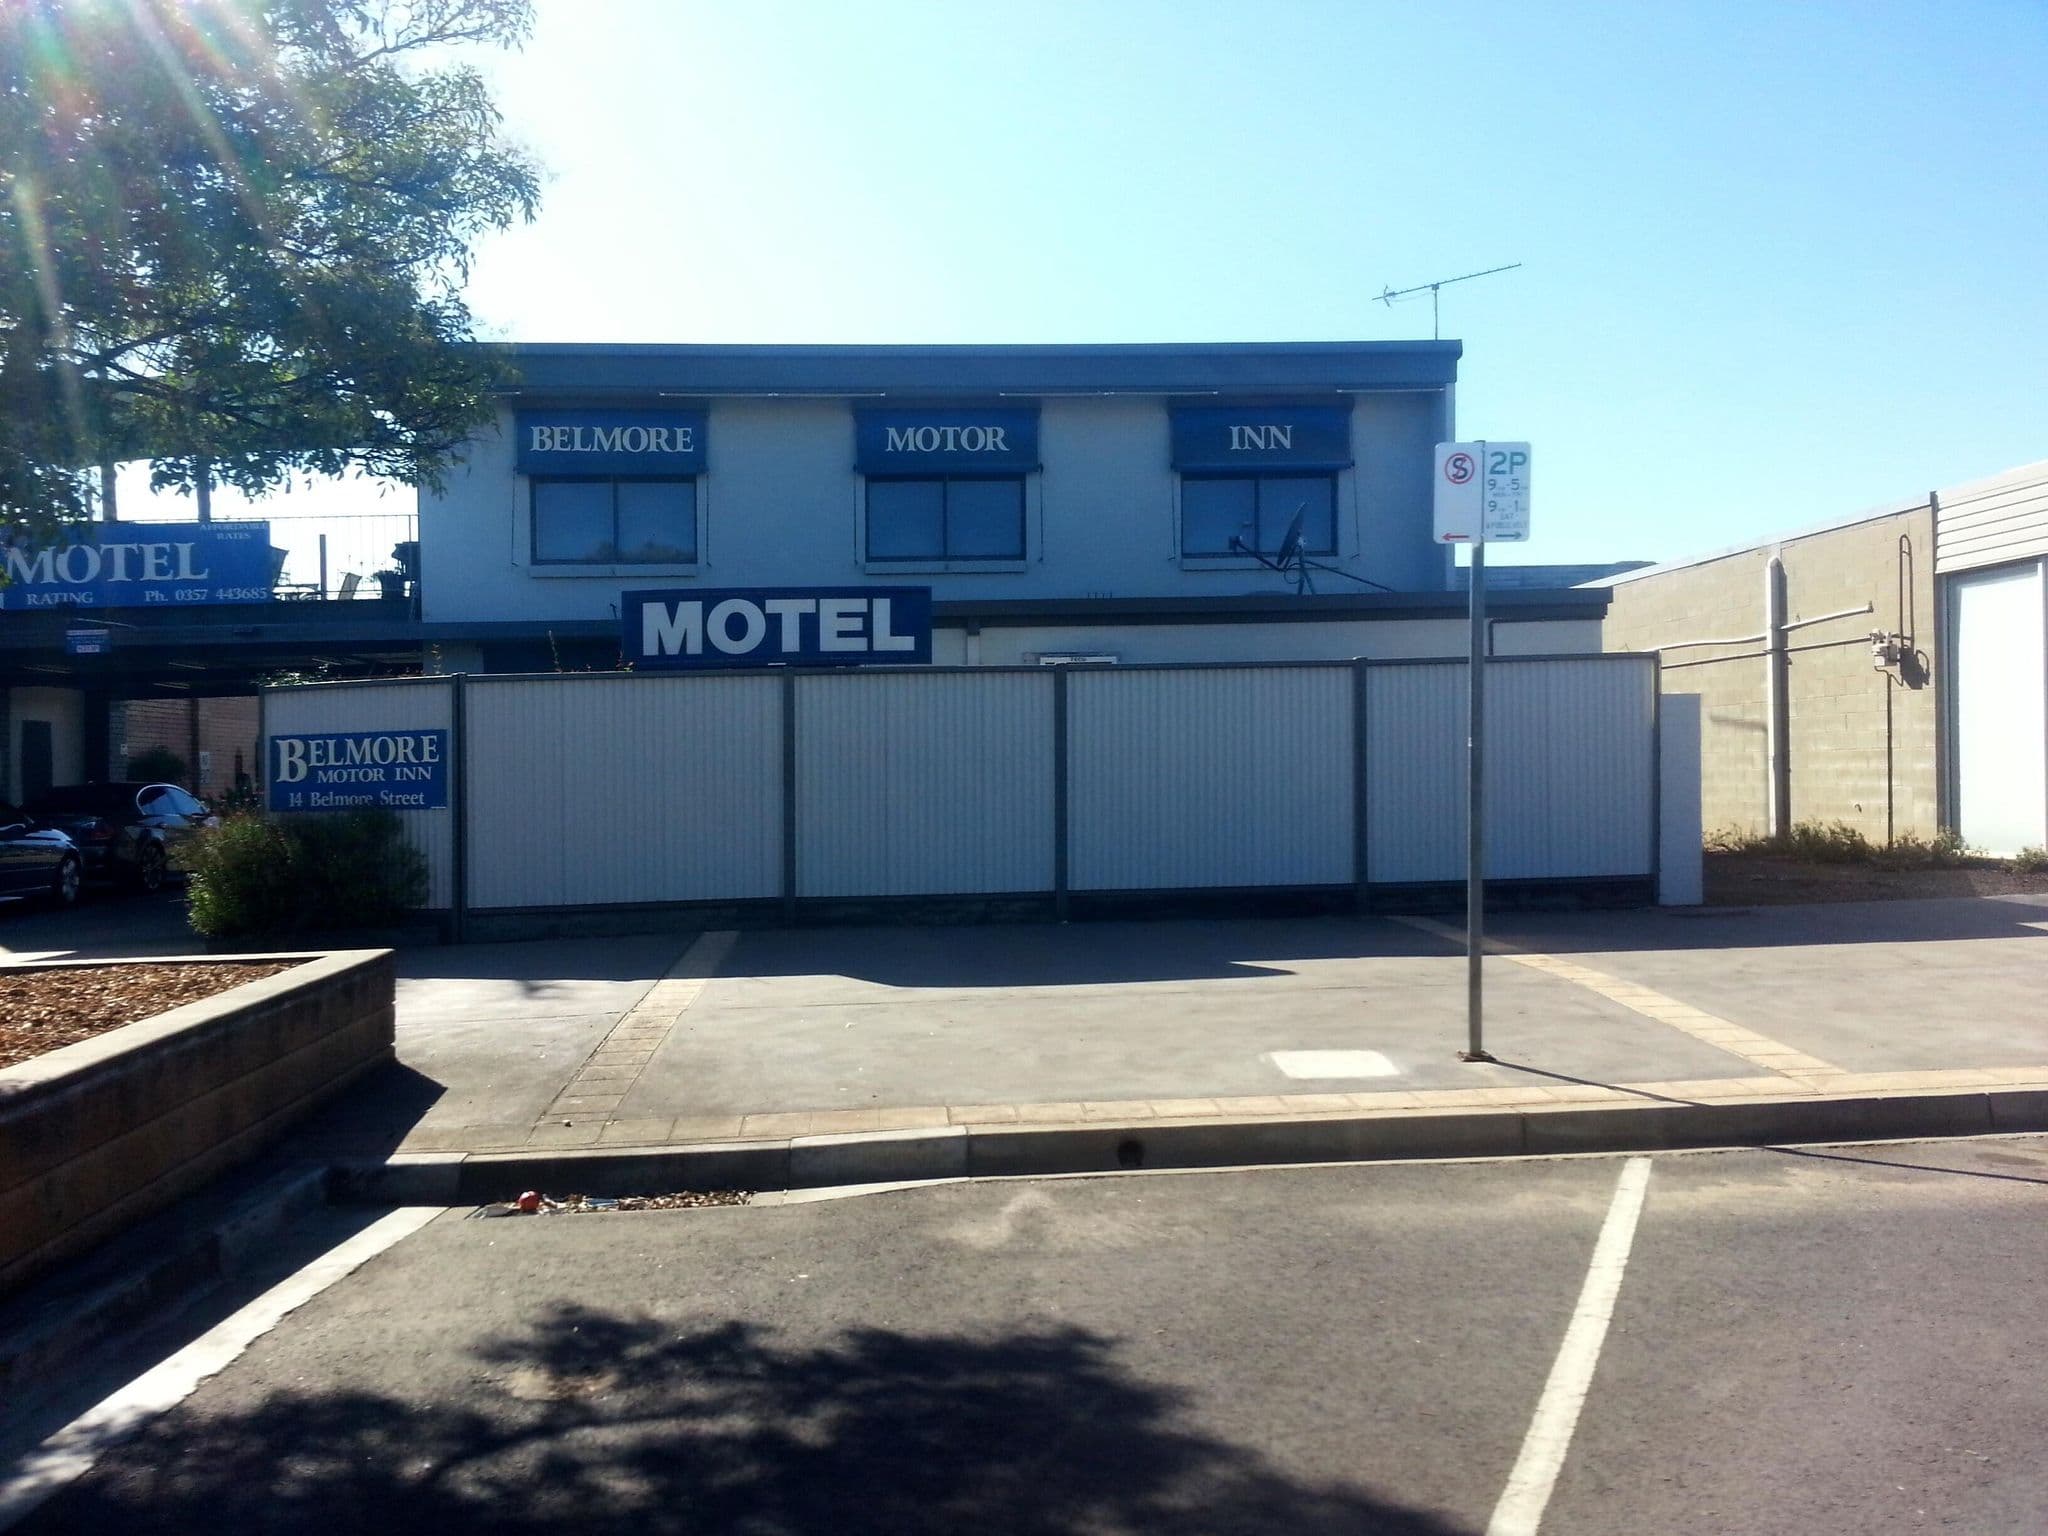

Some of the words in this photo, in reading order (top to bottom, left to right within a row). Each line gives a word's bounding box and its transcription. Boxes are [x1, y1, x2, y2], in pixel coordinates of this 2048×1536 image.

[529, 425, 695, 453] BELMORE
[885, 426, 1011, 453] MOTOR
[1229, 424, 1293, 451] INN
[1489, 451, 1528, 475] 2P
[1487, 478, 1497, 491] 9
[1487, 500, 1497, 512] 9
[7, 542, 208, 585] MOTEL
[27, 591, 93, 606] RATING
[175, 588, 208, 601] 0357
[216, 587, 268, 600] 443685
[642, 598, 915, 656] MOTEL
[275, 735, 440, 783] BELMORE
[317, 767, 386, 783] MOTOR
[394, 766, 432, 781] INN
[289, 792, 303, 807] 14
[311, 791, 373, 807] Belmore
[380, 789, 425, 805] Street
